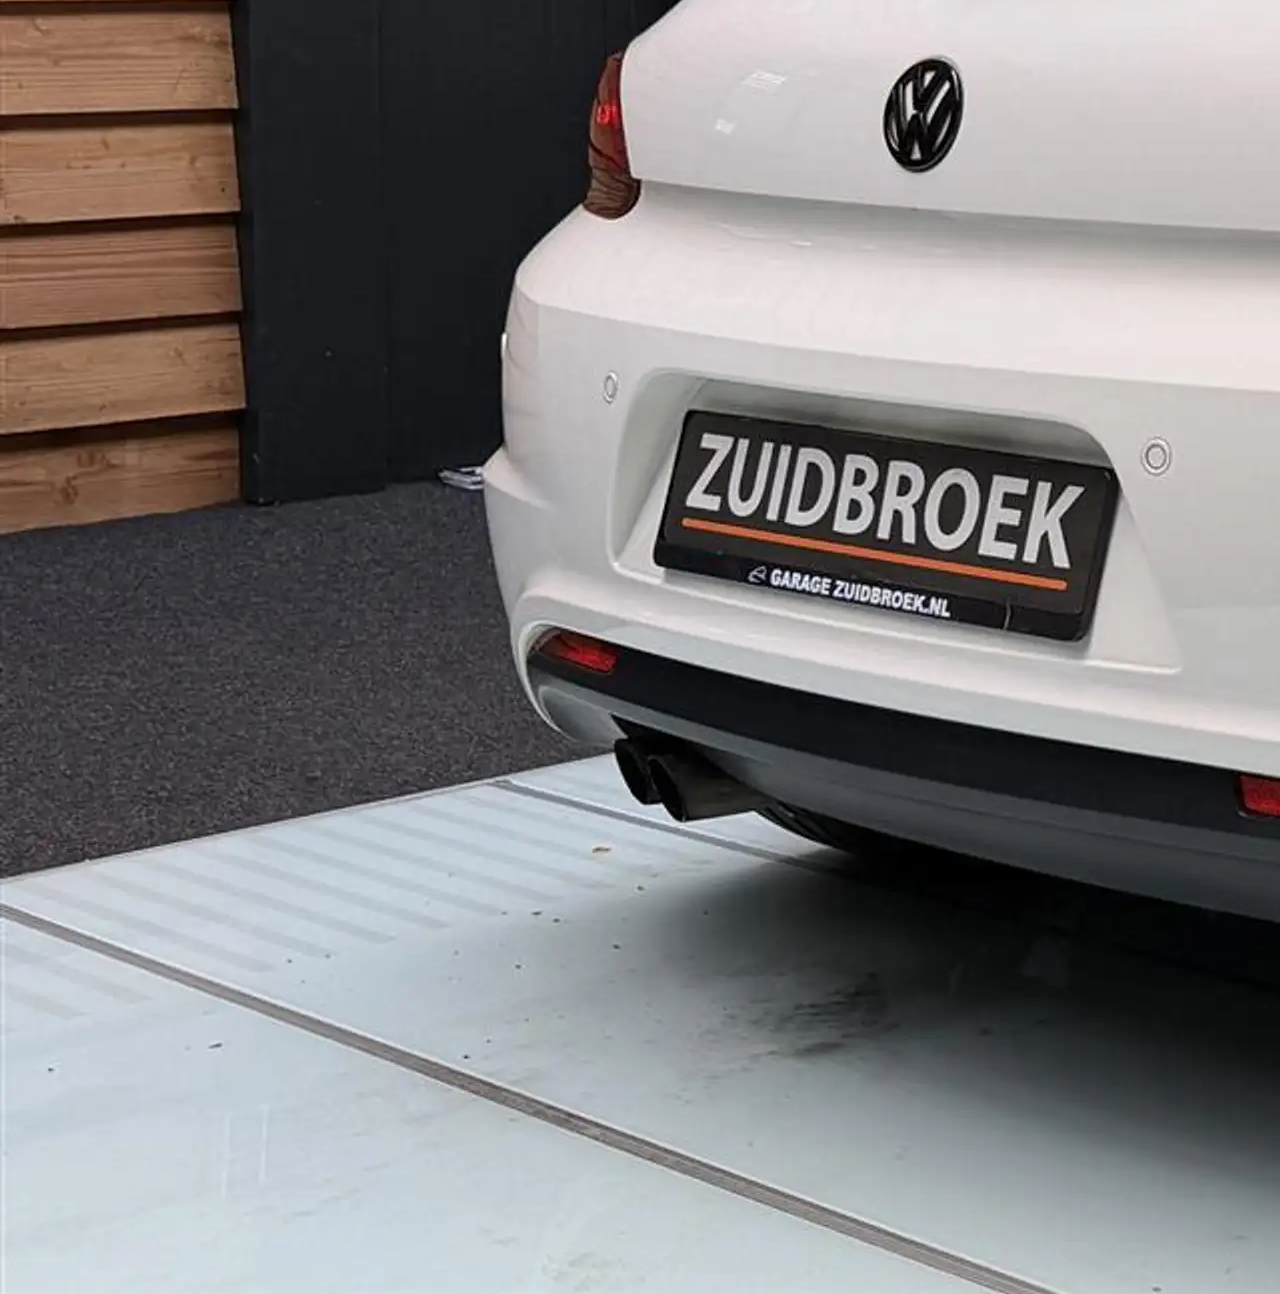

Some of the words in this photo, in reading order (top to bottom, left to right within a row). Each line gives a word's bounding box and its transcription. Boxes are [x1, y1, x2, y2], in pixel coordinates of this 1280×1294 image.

[886, 62, 961, 169] VW
[685, 432, 1086, 570] ZUIDBROEK
[770, 568, 831, 595] GARAGE
[833, 580, 951, 618] ZUIDBROEK.NL
